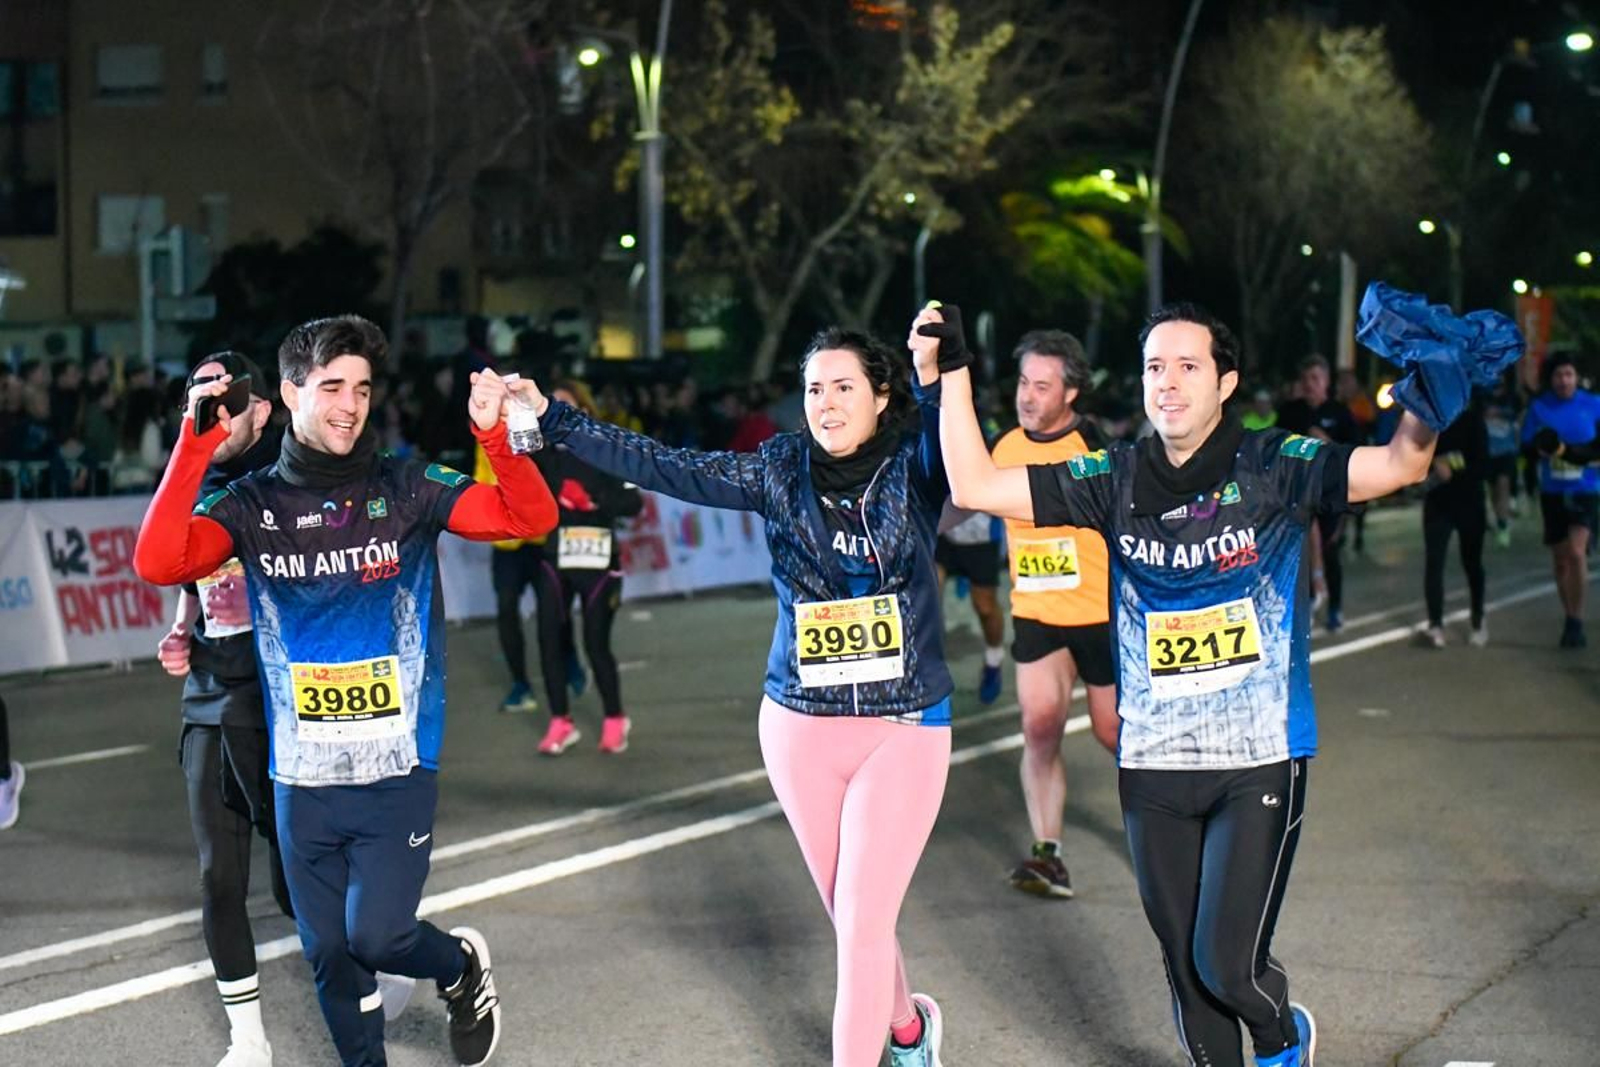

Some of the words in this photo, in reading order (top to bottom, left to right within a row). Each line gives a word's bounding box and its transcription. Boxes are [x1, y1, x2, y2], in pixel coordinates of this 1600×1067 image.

[45, 526, 89, 576] 42
[88, 525, 139, 578] SA
[259, 553, 306, 577] SAN
[314, 537, 397, 577] ANTÓN
[1119, 534, 1165, 566] SAN
[1172, 524, 1257, 569] ANTÓN
[1215, 542, 1260, 572] 2025
[361, 556, 401, 583] 2025
[1019, 555, 1072, 574] 4162
[814, 606, 832, 619] 42
[1165, 617, 1183, 631] 42
[804, 620, 893, 655] 3990
[1155, 625, 1246, 666] 3217
[312, 667, 331, 681] 42
[302, 682, 392, 713] 3980
